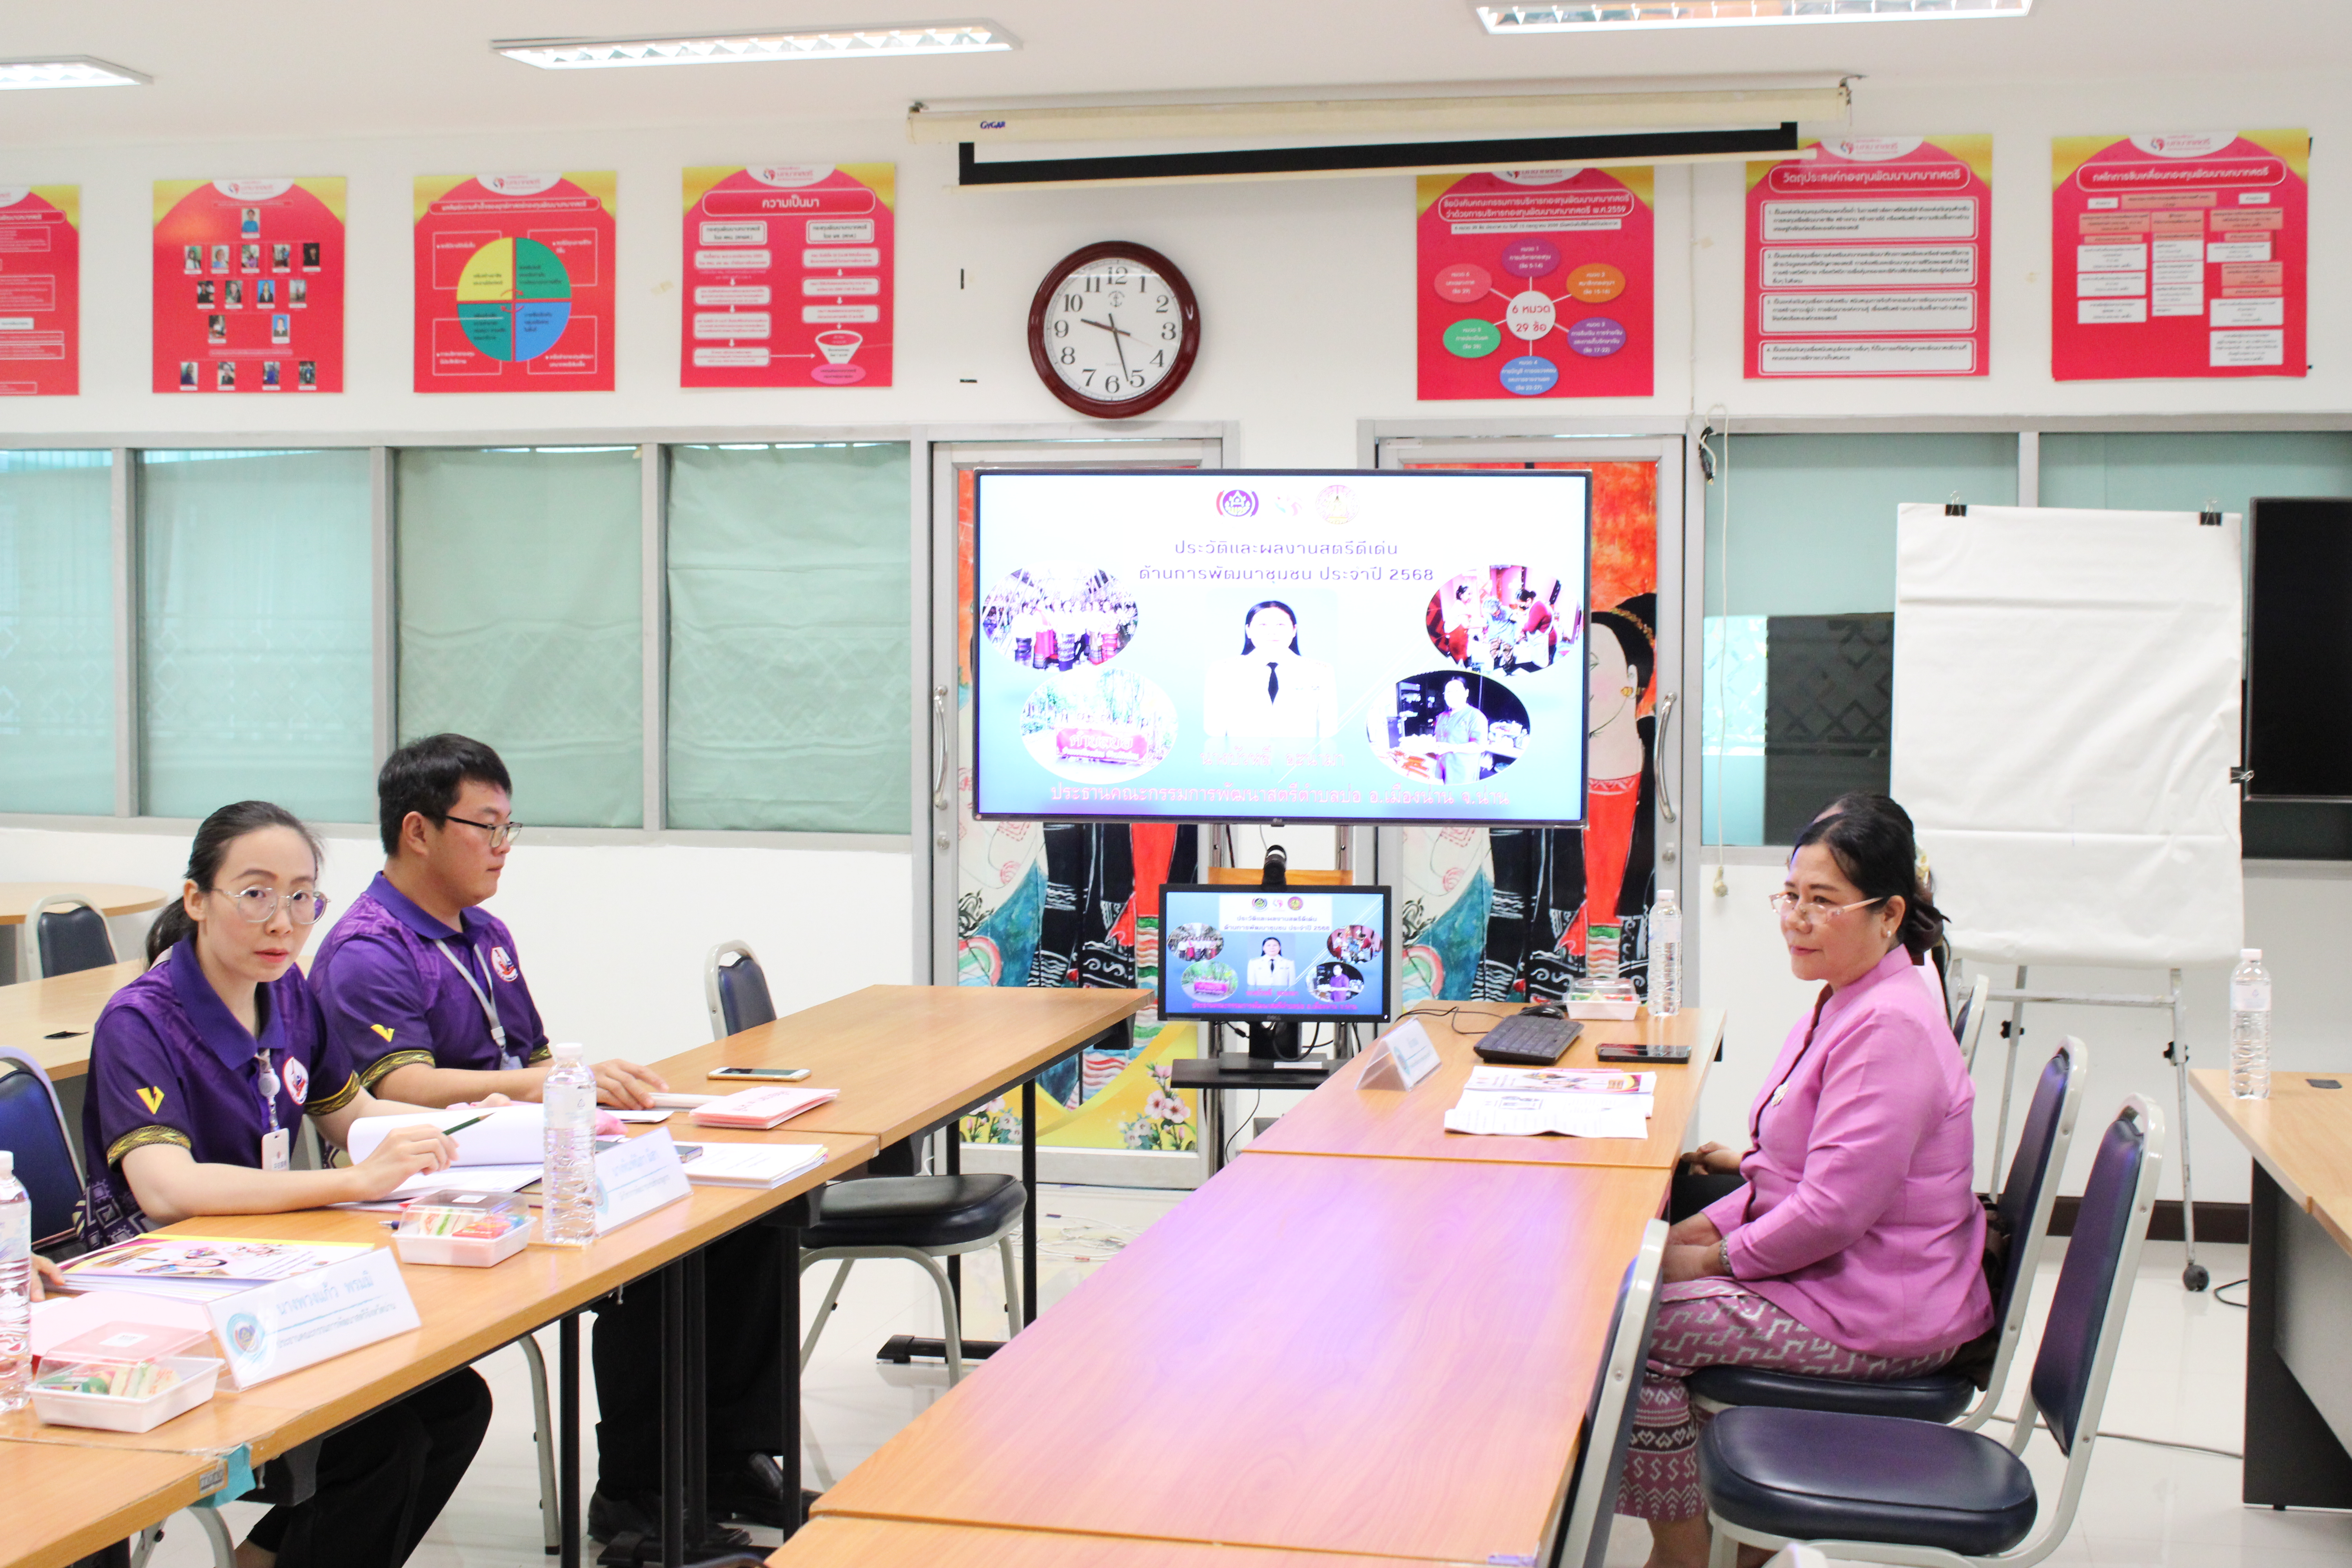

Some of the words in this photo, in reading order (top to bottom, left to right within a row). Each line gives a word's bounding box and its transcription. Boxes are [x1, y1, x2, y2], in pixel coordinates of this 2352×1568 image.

[762, 194, 820, 209] ความเป็นมา
[1084, 276, 1101, 293] 11
[1106, 267, 1128, 285] 12
[1140, 275, 1147, 293] 1
[1063, 294, 1083, 312] 10
[1156, 295, 1169, 313] 2
[1512, 305, 1519, 314] 6
[1523, 305, 1550, 313] หมวด
[1054, 320, 1069, 338] 9
[1161, 322, 1176, 340] 3
[1516, 323, 1529, 332] 29
[1533, 320, 1547, 332] ข้อ
[1061, 347, 1076, 365] 8
[1149, 349, 1164, 368] 4
[1082, 368, 1097, 387] 7
[1105, 375, 1120, 394] 6
[1130, 369, 1145, 388] 5
[1174, 540, 1399, 555] ประวัติและผลงานสตรีดีเด่น
[1139, 565, 1312, 584] ด้านการพัฒนาชุมชน
[1319, 565, 1383, 581] ประจำปี
[1388, 568, 1434, 581] 2568
[1050, 781, 1362, 803] ประธานคณะกรรมการพัฒนาสตรีตำบลบ่อ
[1368, 782, 1455, 805] อ.เมืองน่าน
[1461, 785, 1511, 806] จ.น่าน
